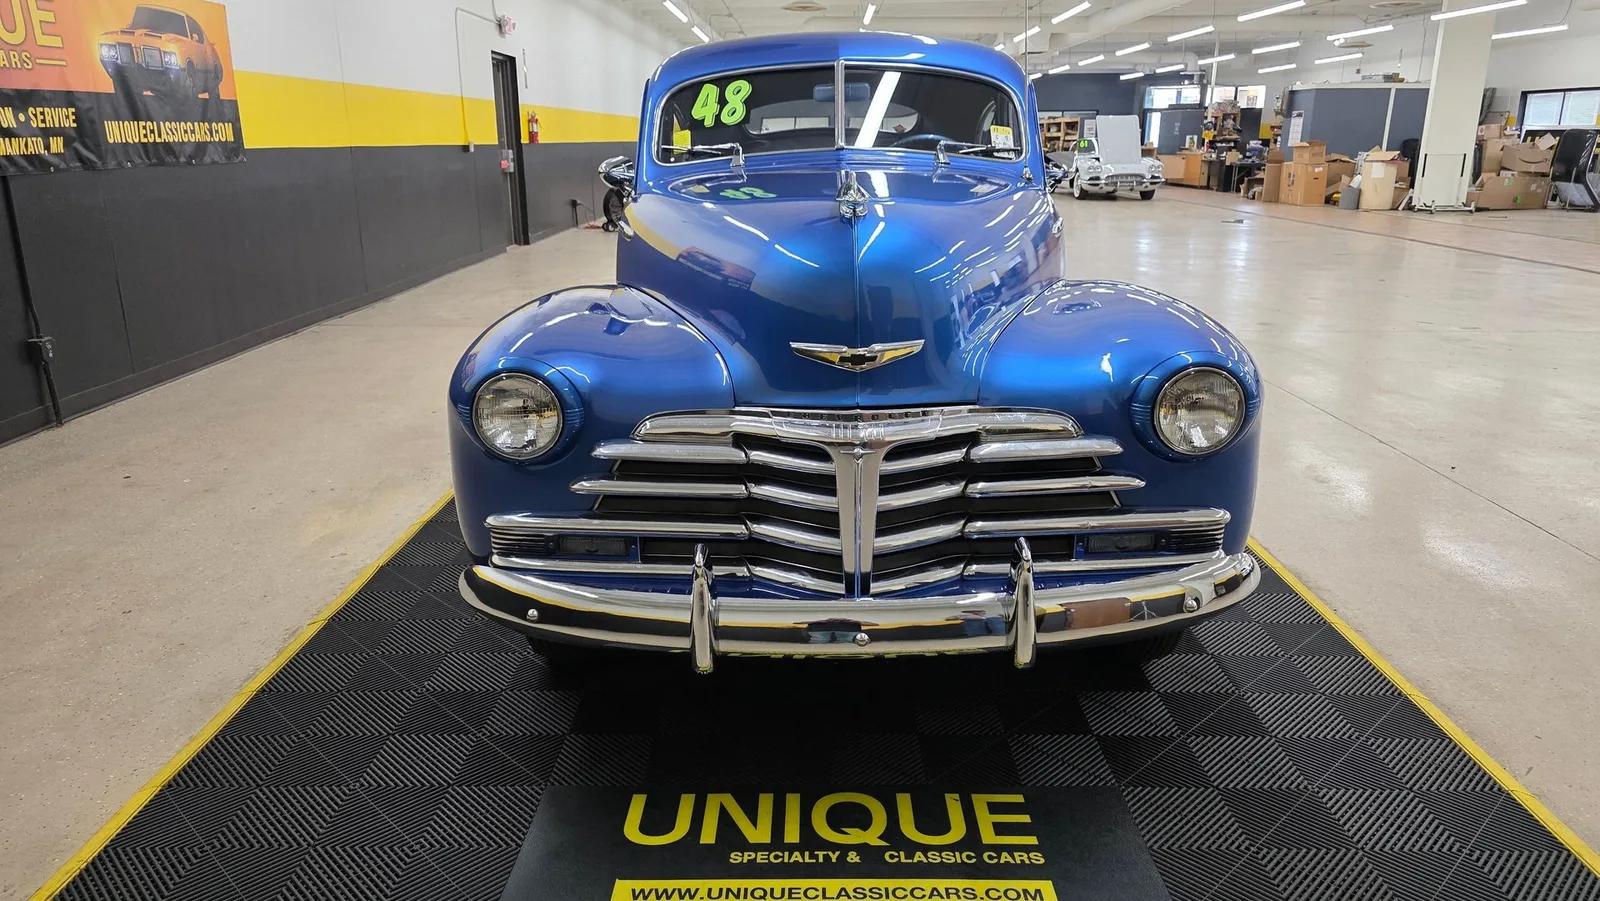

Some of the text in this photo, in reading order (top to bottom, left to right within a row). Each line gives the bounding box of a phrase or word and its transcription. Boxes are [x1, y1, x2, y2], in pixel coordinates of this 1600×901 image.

[691, 79, 752, 128] 48
[28, 107, 77, 128] SERVICE
[104, 120, 234, 144] UNIQUECLASSICCARS.COM
[49, 136, 65, 153] MN
[1079, 140, 1089, 148] 61
[623, 792, 1039, 846] UNIQUE
[729, 850, 1045, 865] SPECIALTY & CLASSIC CARS
[630, 886, 1043, 901] WWW.UNIQUECLASSICCARS.COM
